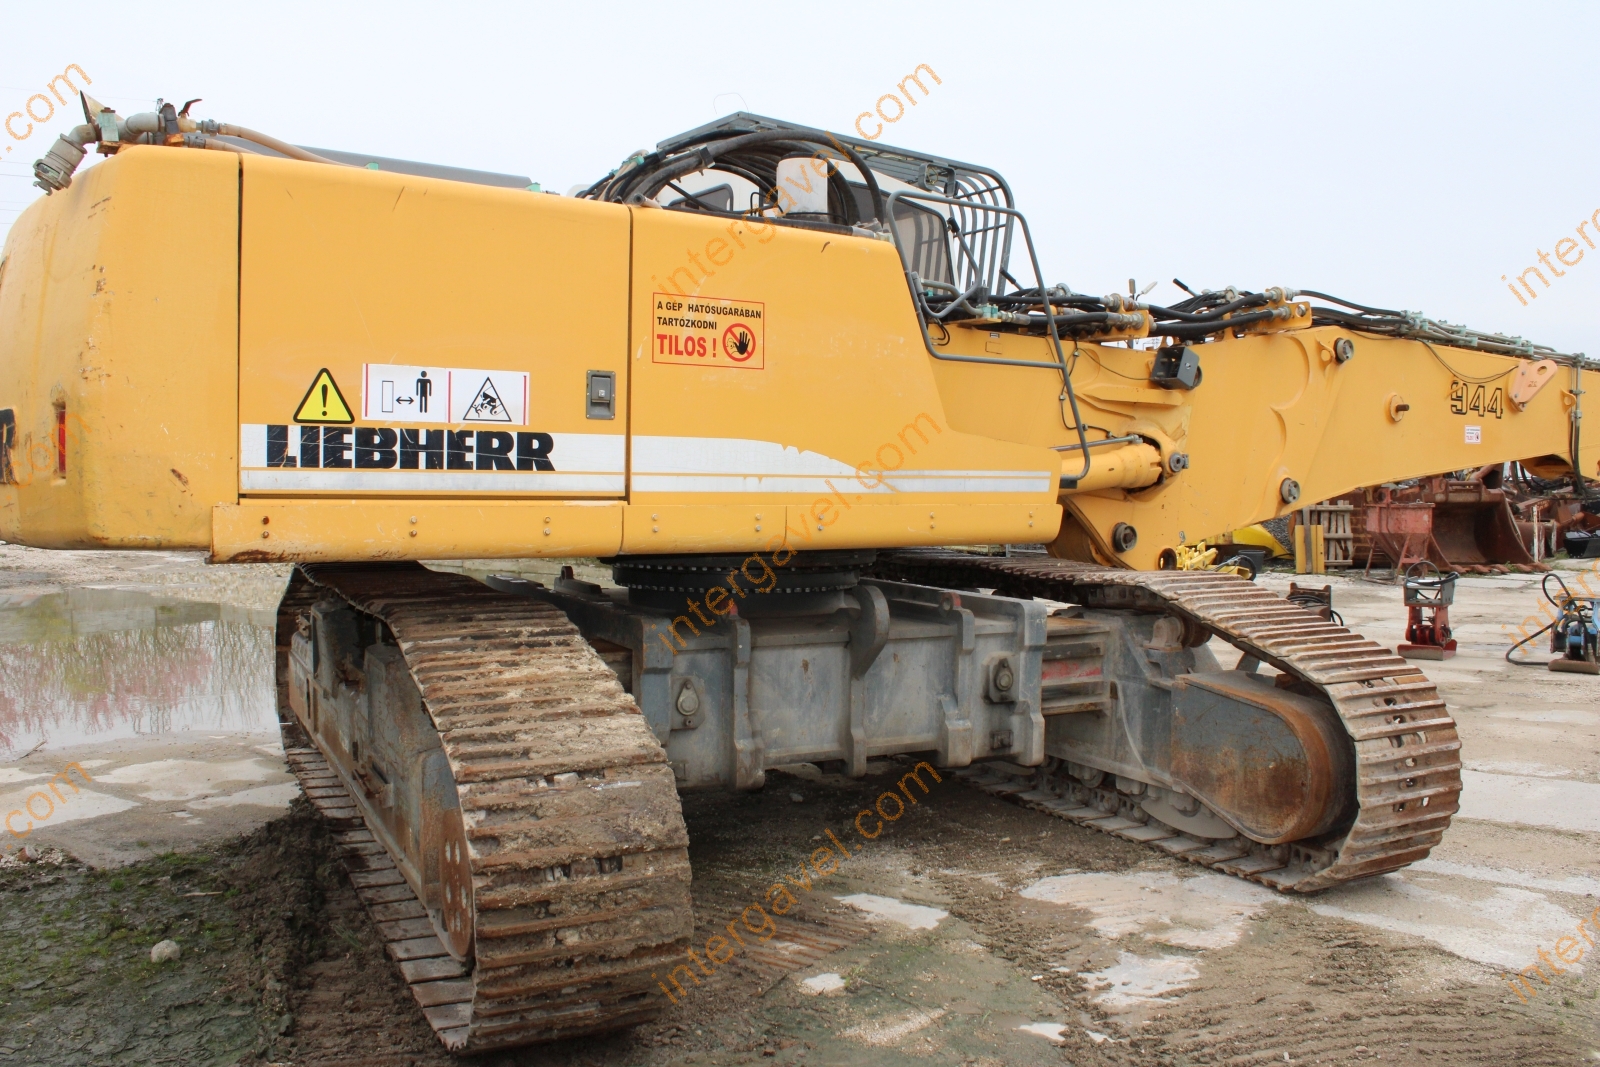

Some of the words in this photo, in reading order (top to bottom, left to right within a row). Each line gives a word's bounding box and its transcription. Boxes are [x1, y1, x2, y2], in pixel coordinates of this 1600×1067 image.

[656, 300, 664, 310] A
[665, 300, 683, 312] GÉP
[688, 302, 762, 319] HATÓSUGARÁBAN
[657, 315, 718, 330] TARTÓZKODNI
[656, 333, 707, 358] TILOS
[712, 337, 717, 358] !
[1450, 381, 1504, 420] 944
[266, 424, 556, 472] LIEBHERR
